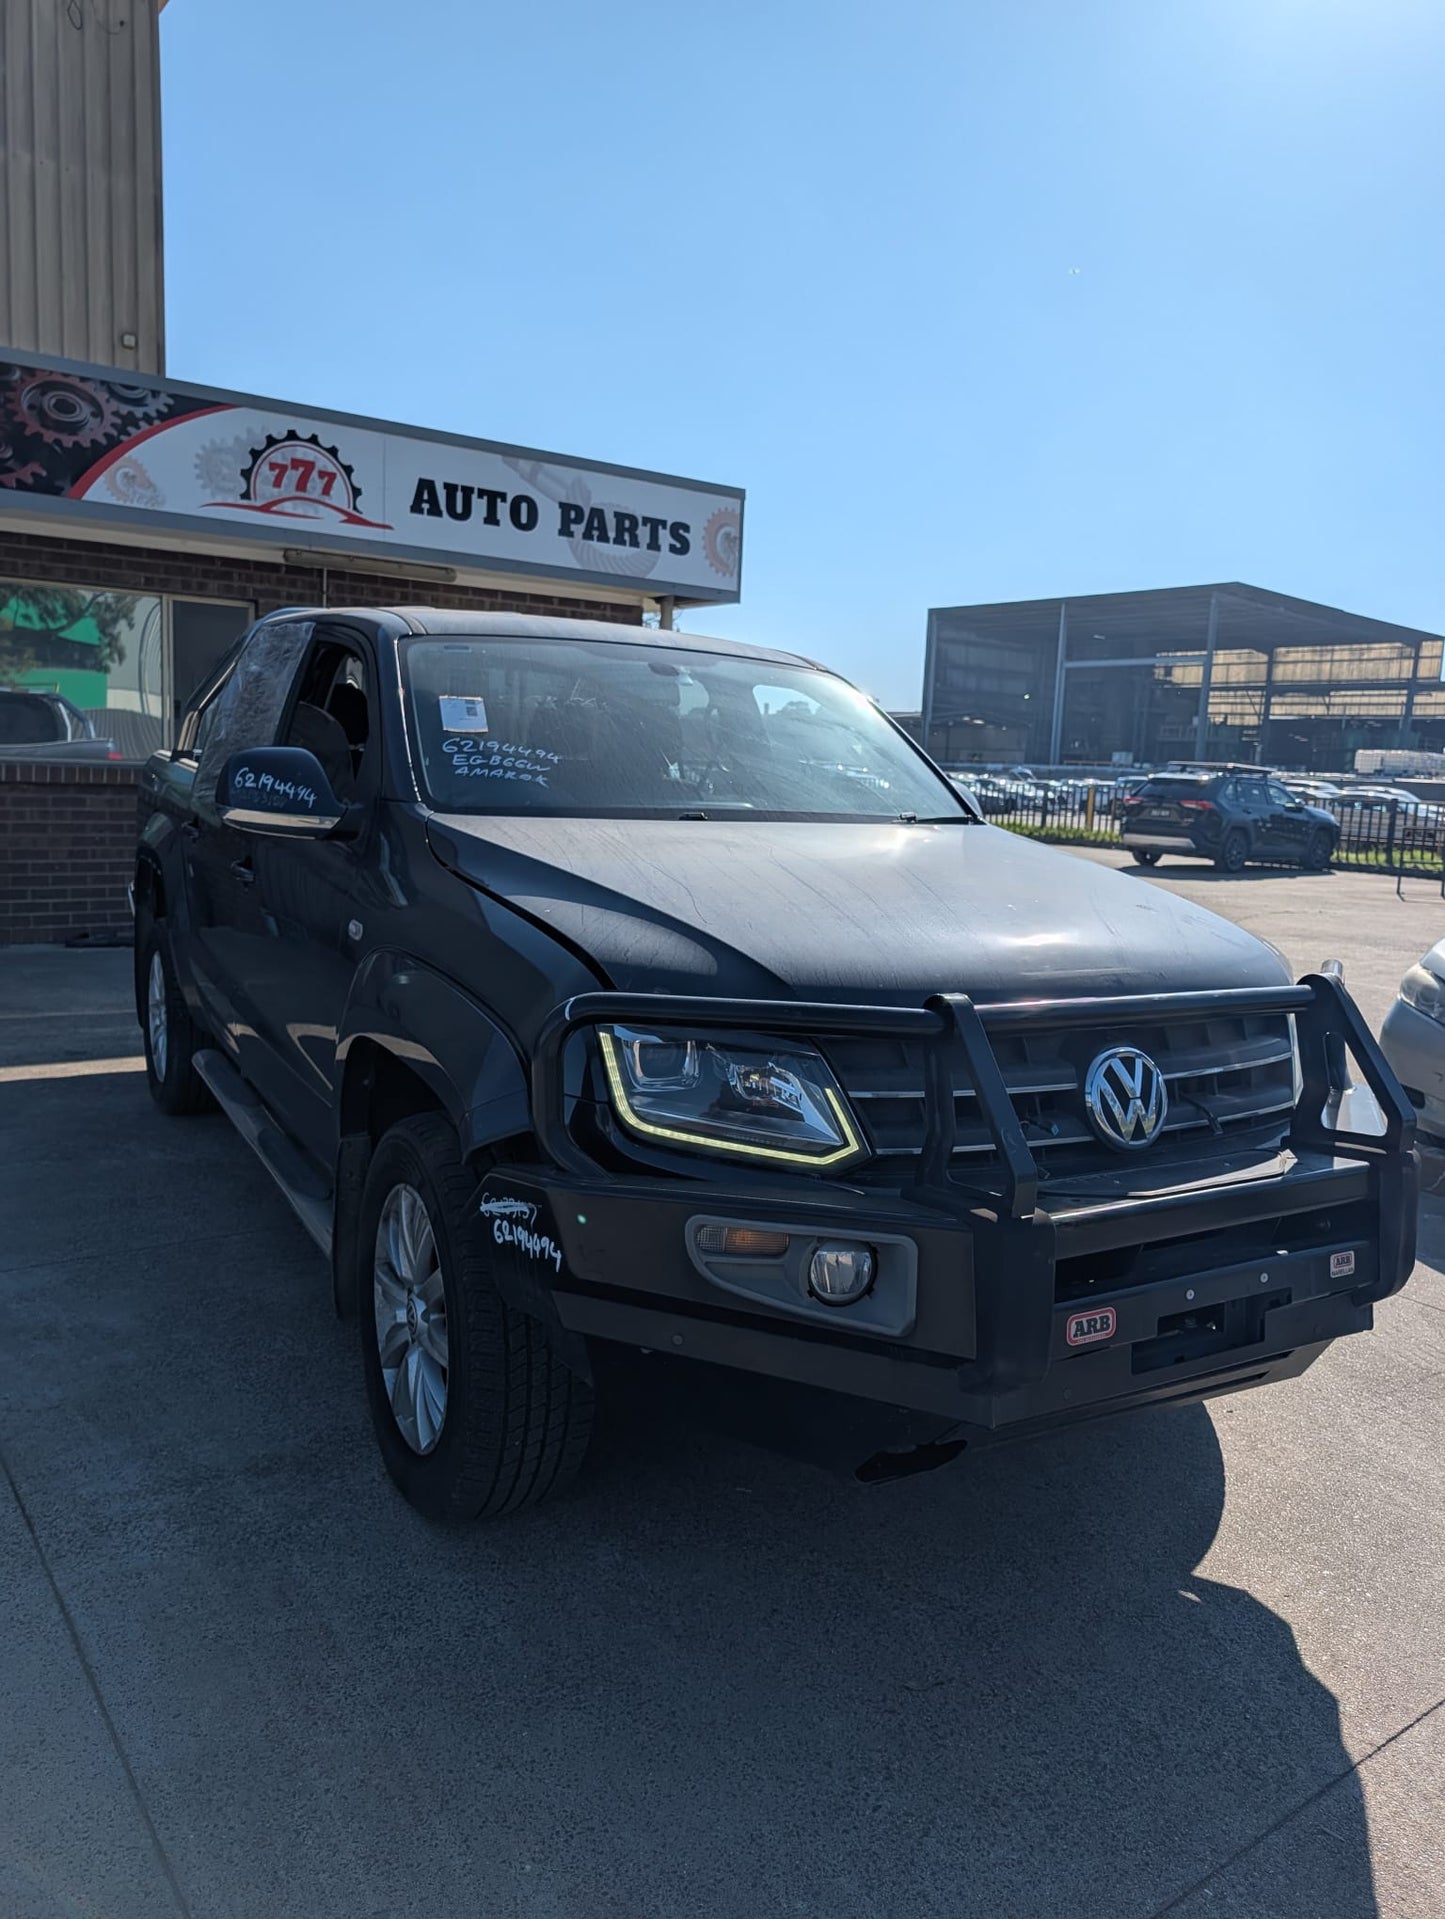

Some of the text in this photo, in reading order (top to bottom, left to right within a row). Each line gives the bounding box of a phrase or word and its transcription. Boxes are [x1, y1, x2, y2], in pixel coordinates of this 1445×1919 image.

[268, 457, 338, 497] 777
[409, 477, 692, 556] AUTO PARTS
[442, 737, 560, 765] 62194494
[234, 767, 318, 809] 62194494
[455, 765, 550, 789] AMAROK
[493, 1218, 562, 1273] 62194494
[1335, 1254, 1351, 1266] ARB
[1072, 1314, 1112, 1339] ARB
